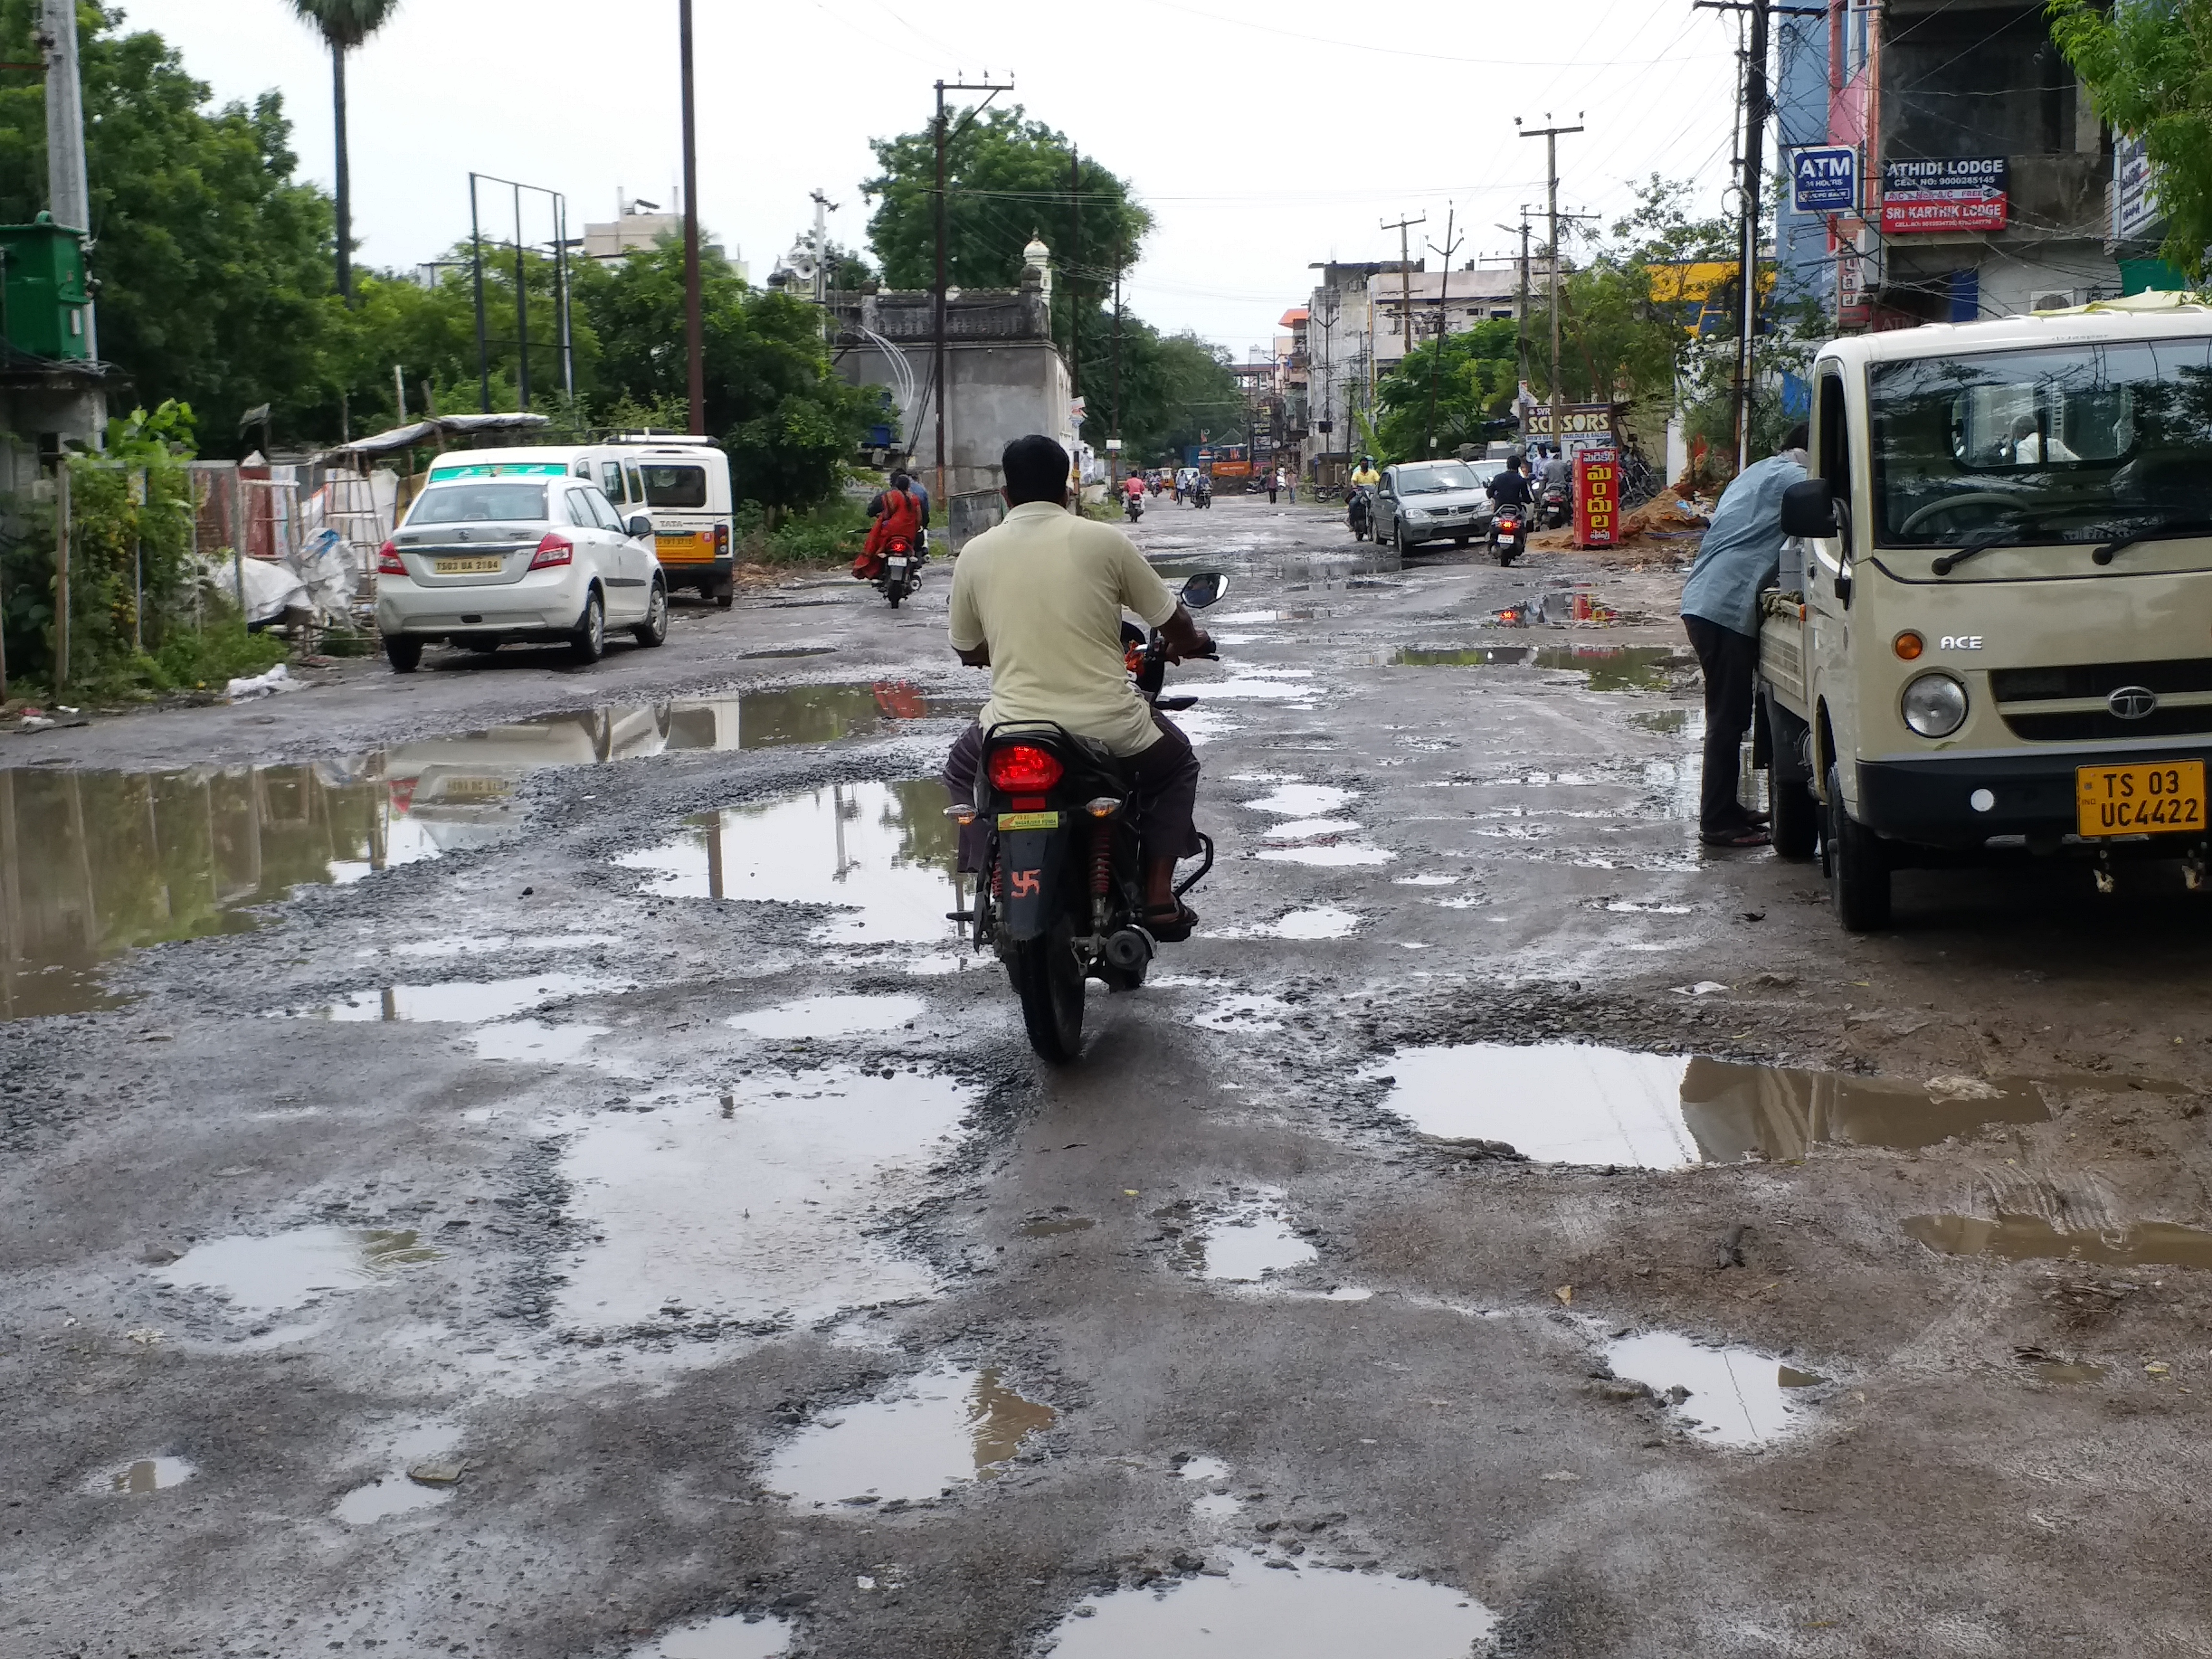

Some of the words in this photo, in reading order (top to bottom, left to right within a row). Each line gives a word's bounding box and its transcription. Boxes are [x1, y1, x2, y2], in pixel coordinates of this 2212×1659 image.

[1798, 156, 1850, 178] ATM
[1887, 162, 1942, 176] ATHIDI
[1948, 159, 2003, 174] LODGE
[1886, 207, 1905, 219] SRI
[1908, 204, 1960, 218] KARTHIK
[1962, 204, 2002, 216] LODGE
[1537, 408, 1551, 416] SVR
[1528, 413, 1609, 433] SCISORS
[1940, 636, 1983, 650] ACE
[2104, 773, 2134, 798] TS
[2149, 770, 2179, 795] 03
[2101, 798, 2199, 828] UC4422
